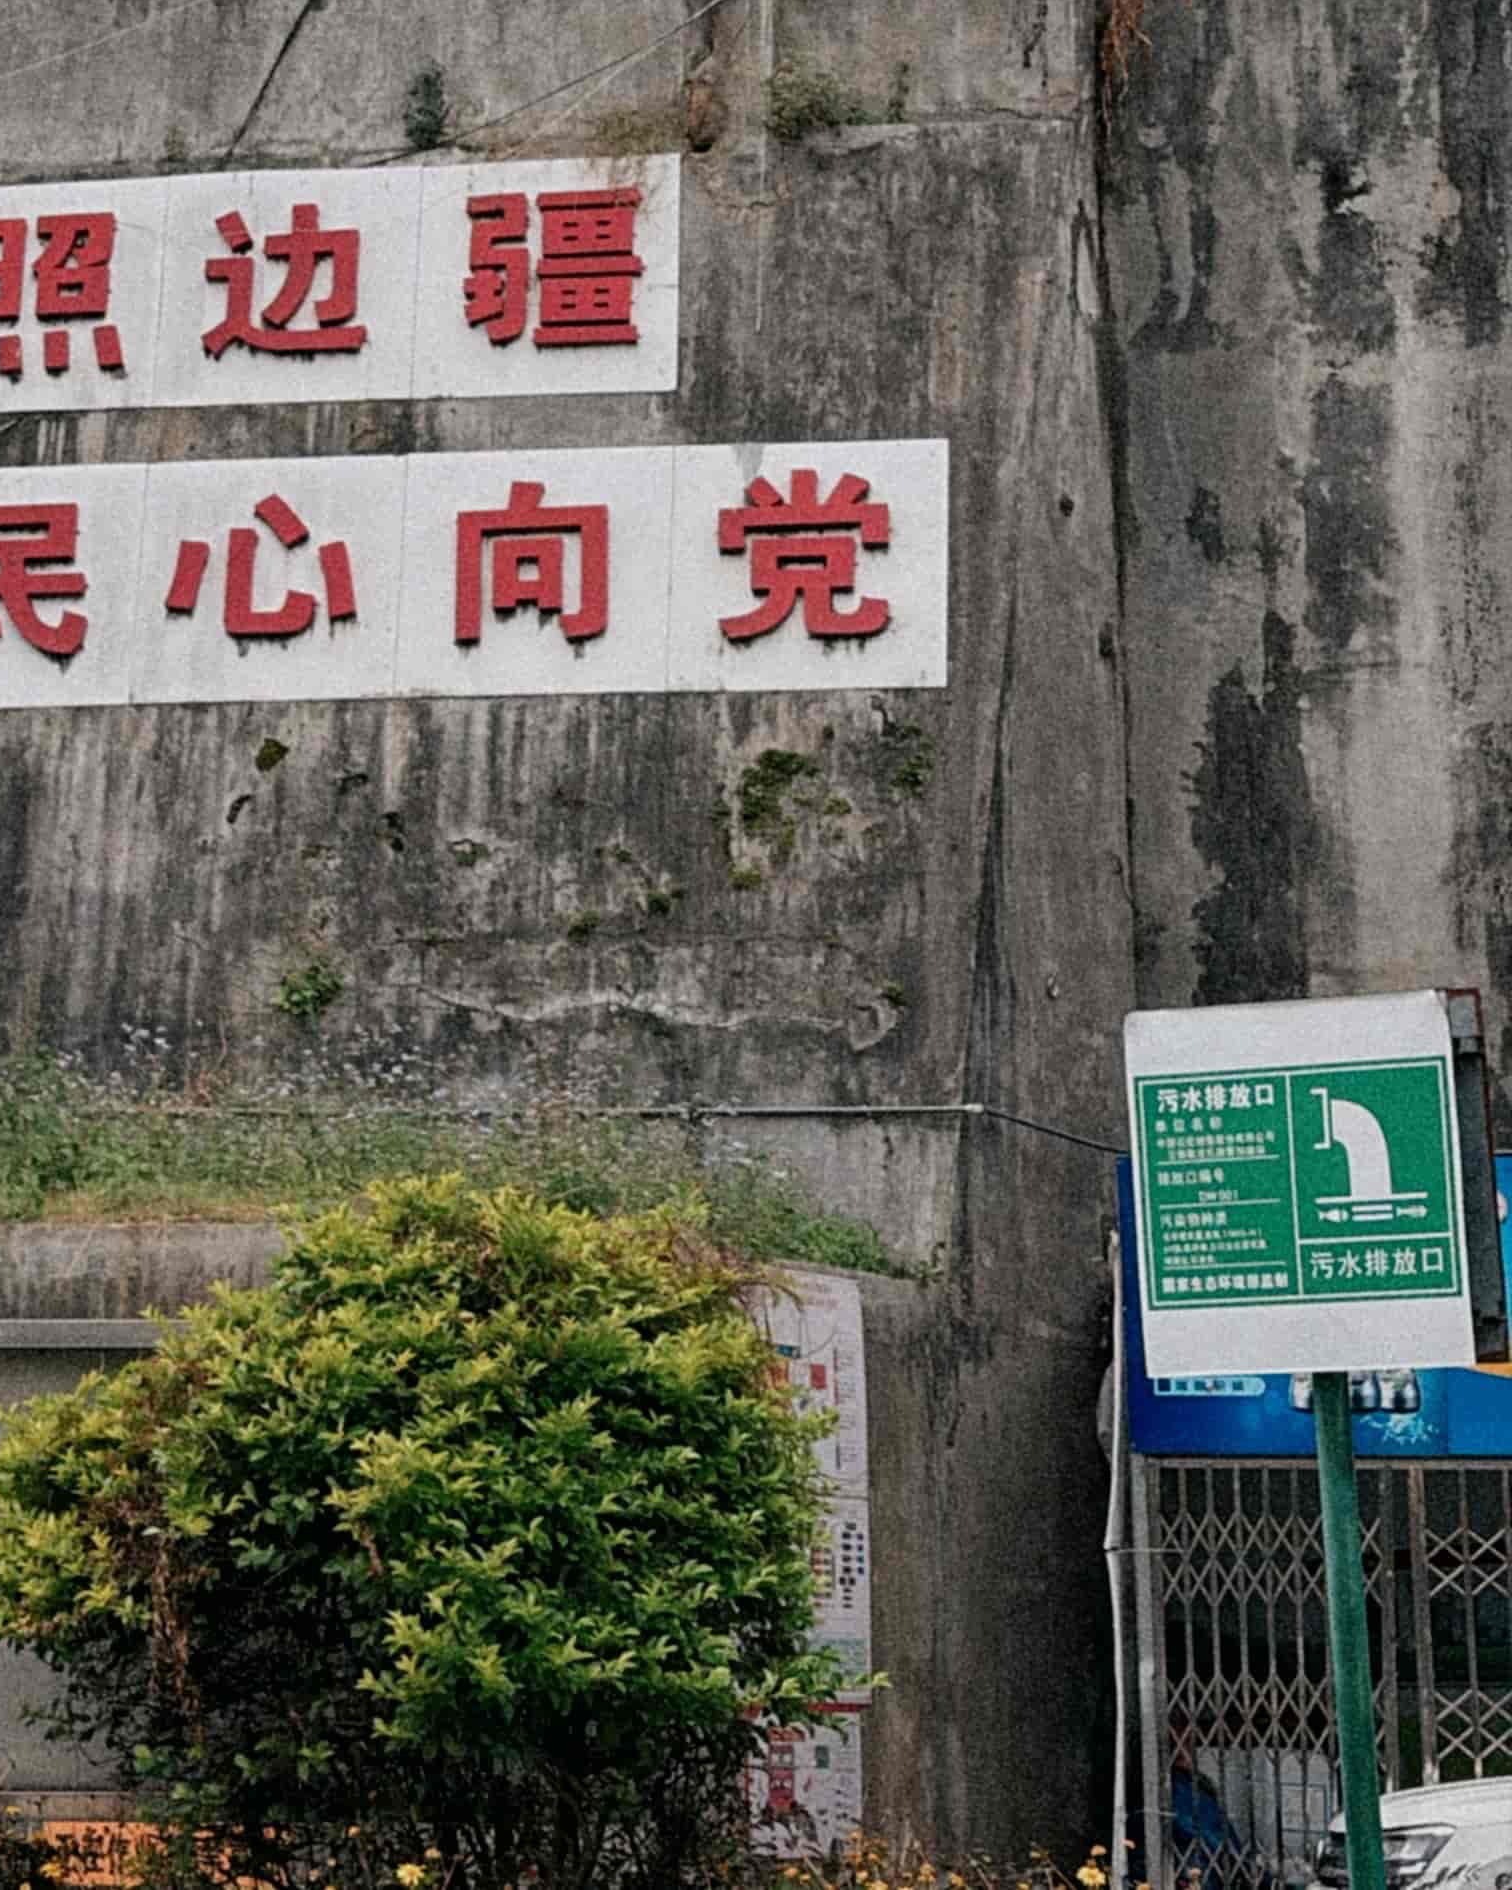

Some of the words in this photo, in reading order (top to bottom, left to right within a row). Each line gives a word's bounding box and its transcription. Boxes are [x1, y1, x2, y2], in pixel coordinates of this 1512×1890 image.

[1157, 1083, 1276, 1113] 污水排放口
[1310, 1246, 1444, 1280] 污水排放口
